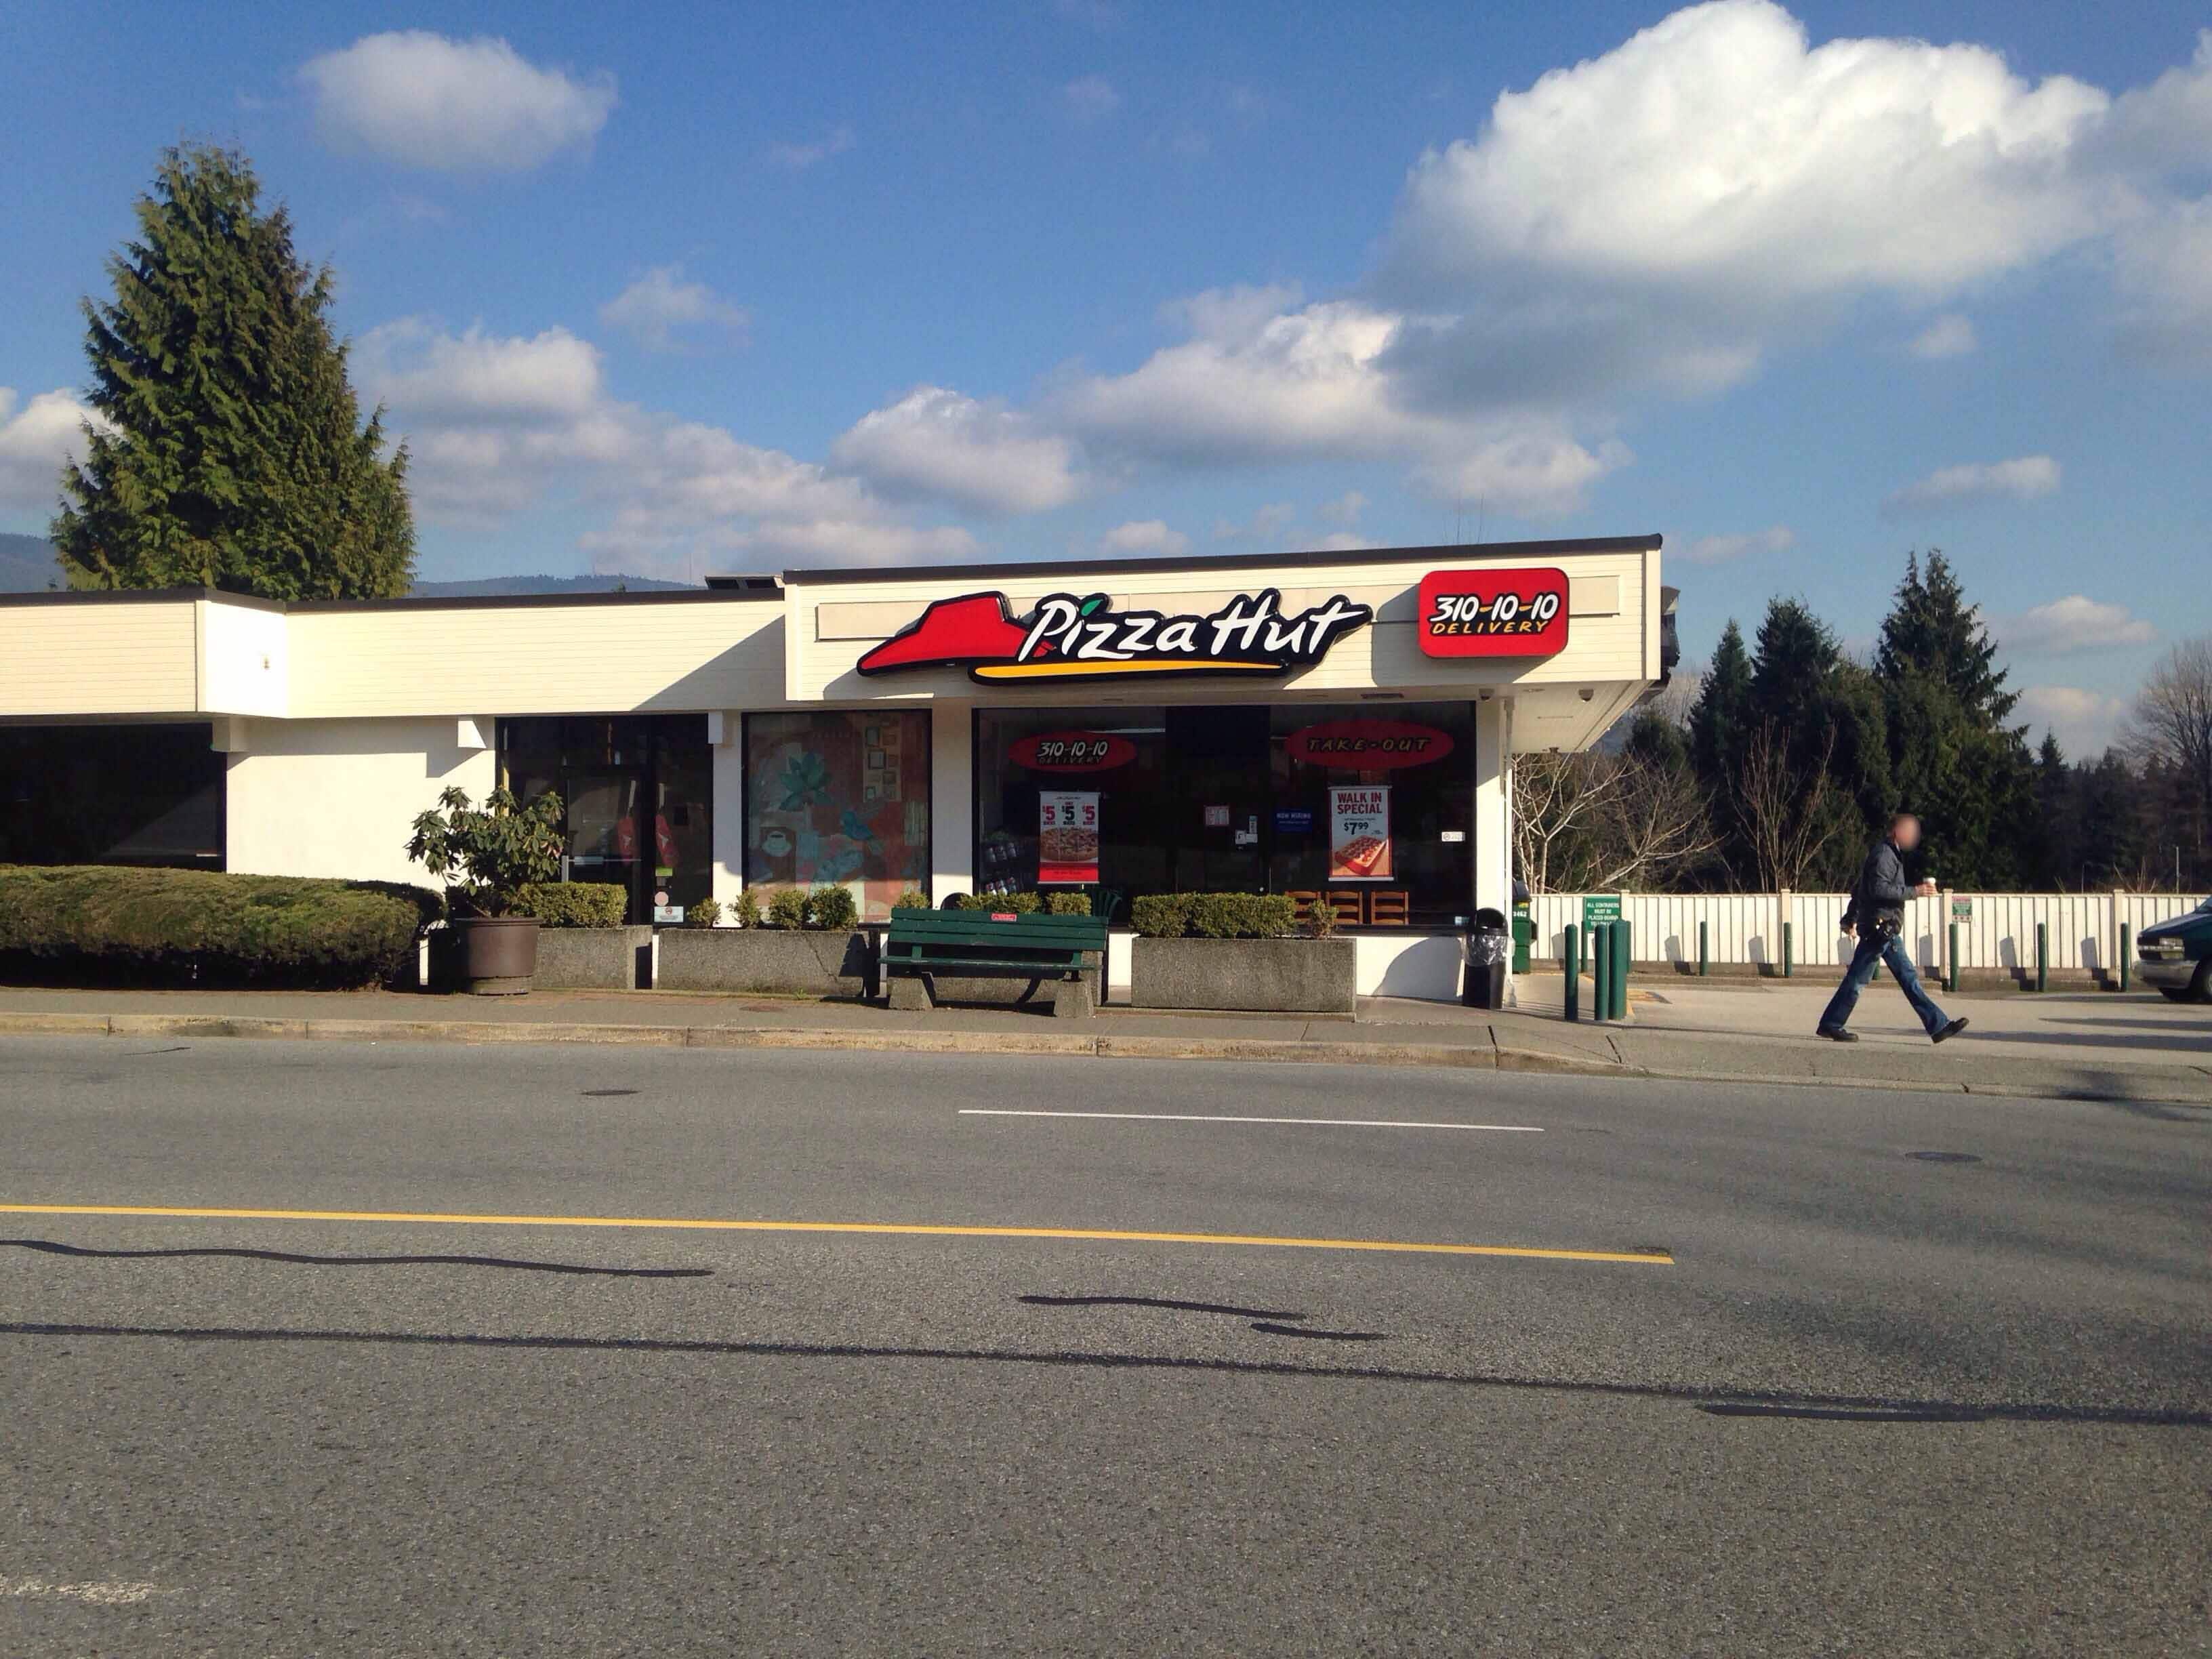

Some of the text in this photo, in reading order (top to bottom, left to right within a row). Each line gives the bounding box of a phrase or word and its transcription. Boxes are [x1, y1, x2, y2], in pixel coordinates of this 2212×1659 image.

[1430, 594, 1559, 621] 310-10-10
[1018, 594, 1371, 661] Pizza Hut
[1432, 621, 1549, 634] DELIVERY
[1037, 741, 1109, 758] 310-10-10
[1308, 737, 1431, 752] TAKE-OUT
[1038, 756, 1103, 765] DELIVERY
[1337, 792, 1382, 803] WALK IN
[1042, 805, 1096, 821] $5 $5 $5
[1337, 803, 1382, 815] SPECIAL
